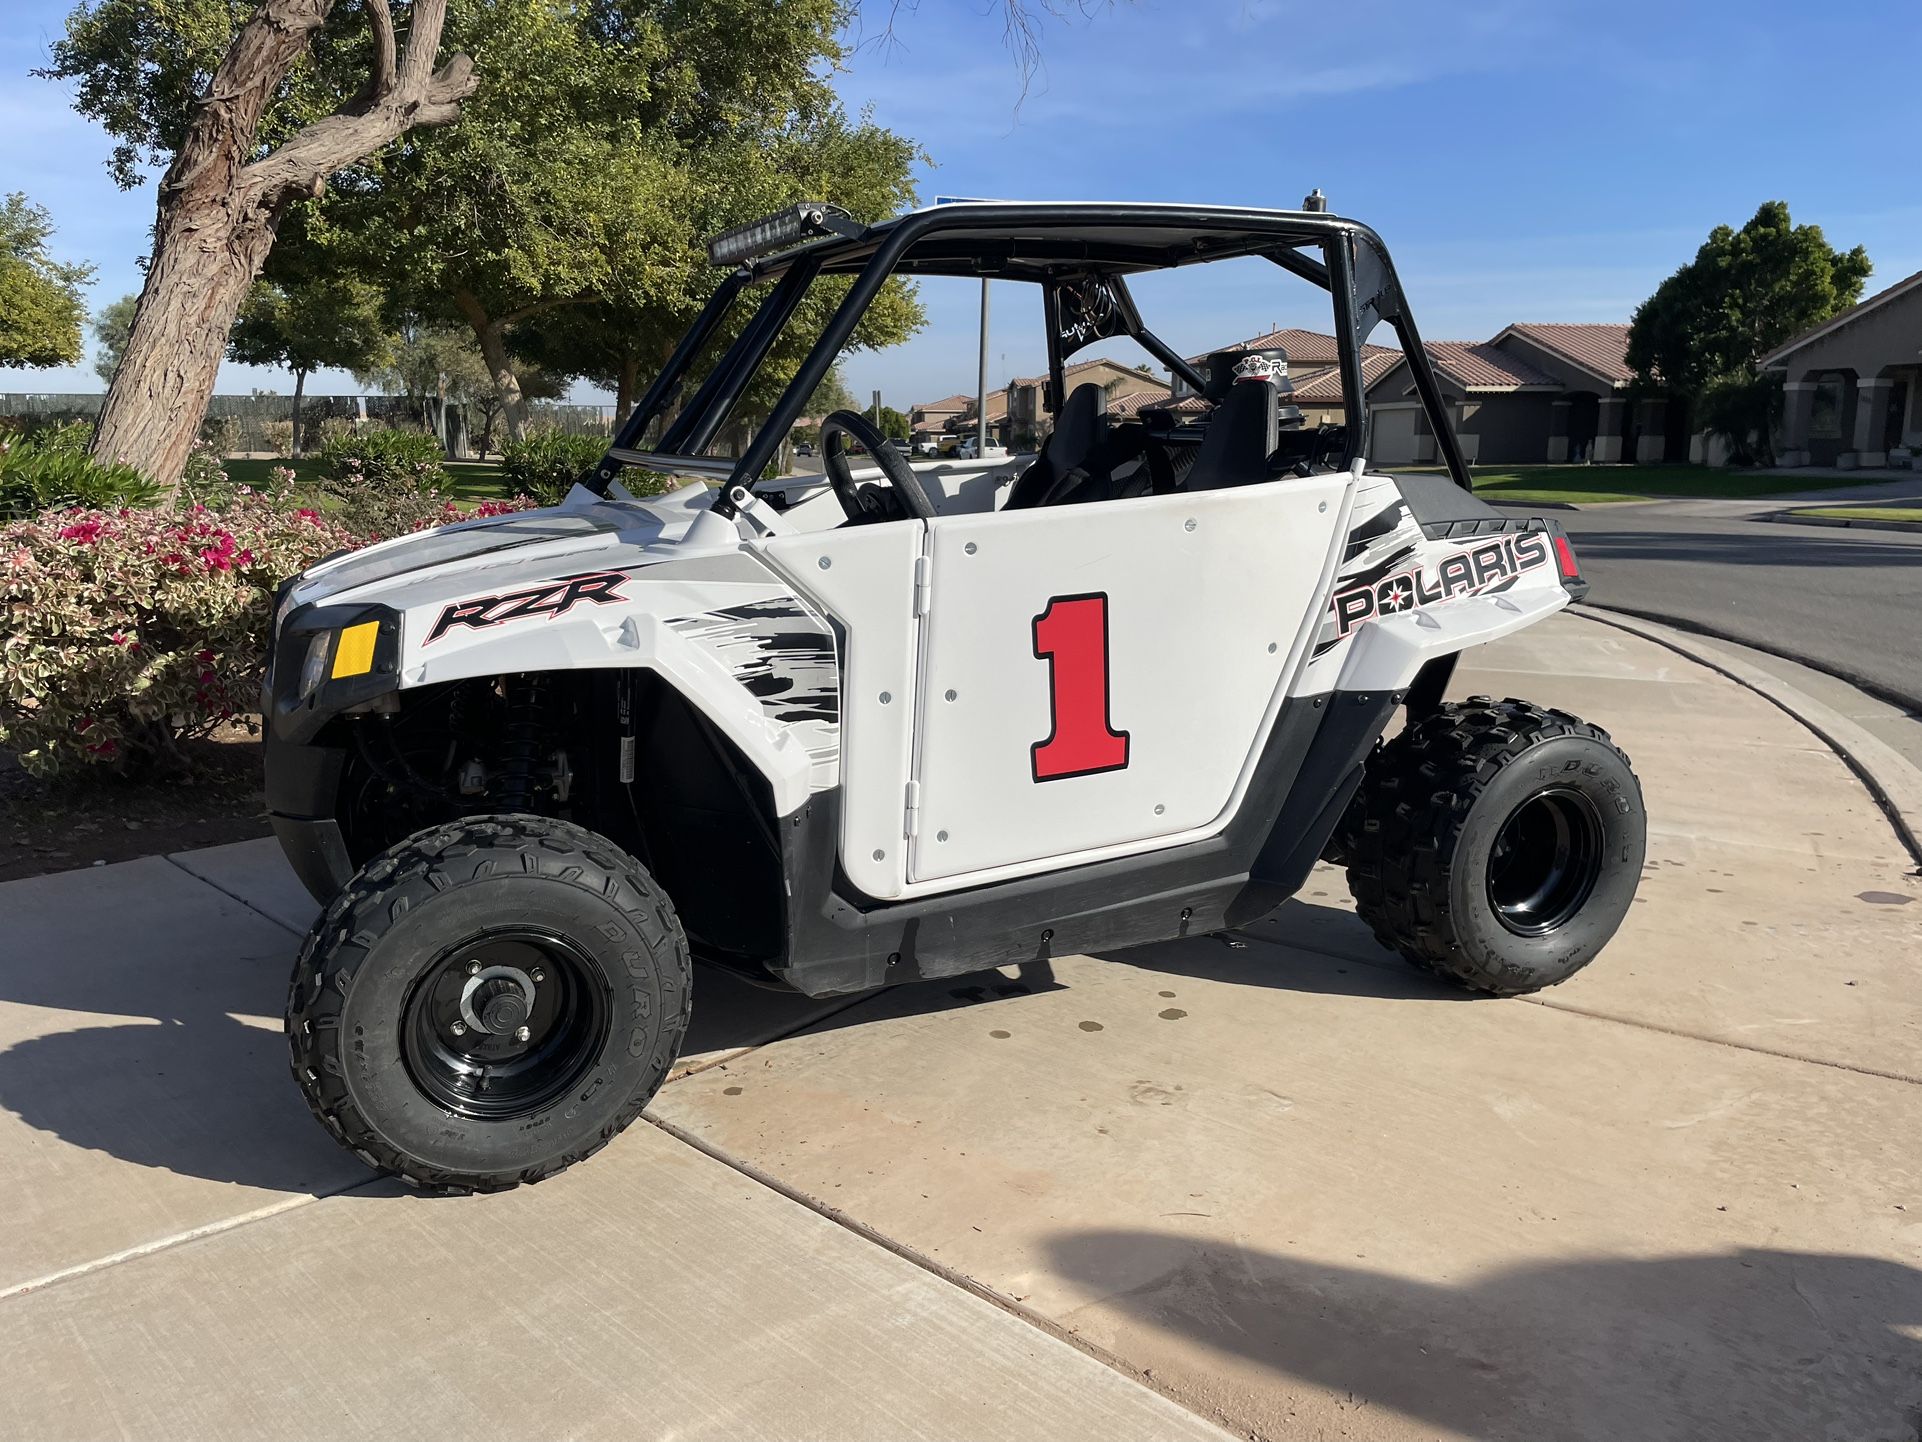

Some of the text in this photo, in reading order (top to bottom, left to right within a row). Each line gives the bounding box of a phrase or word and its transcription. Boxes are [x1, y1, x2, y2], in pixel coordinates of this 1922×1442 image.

[422, 571, 632, 648] RZR
[1333, 533, 1550, 638] POLARIS
[1031, 591, 1130, 784] 1
[1561, 759, 1630, 815] DURO
[595, 919, 652, 1058] DURO
